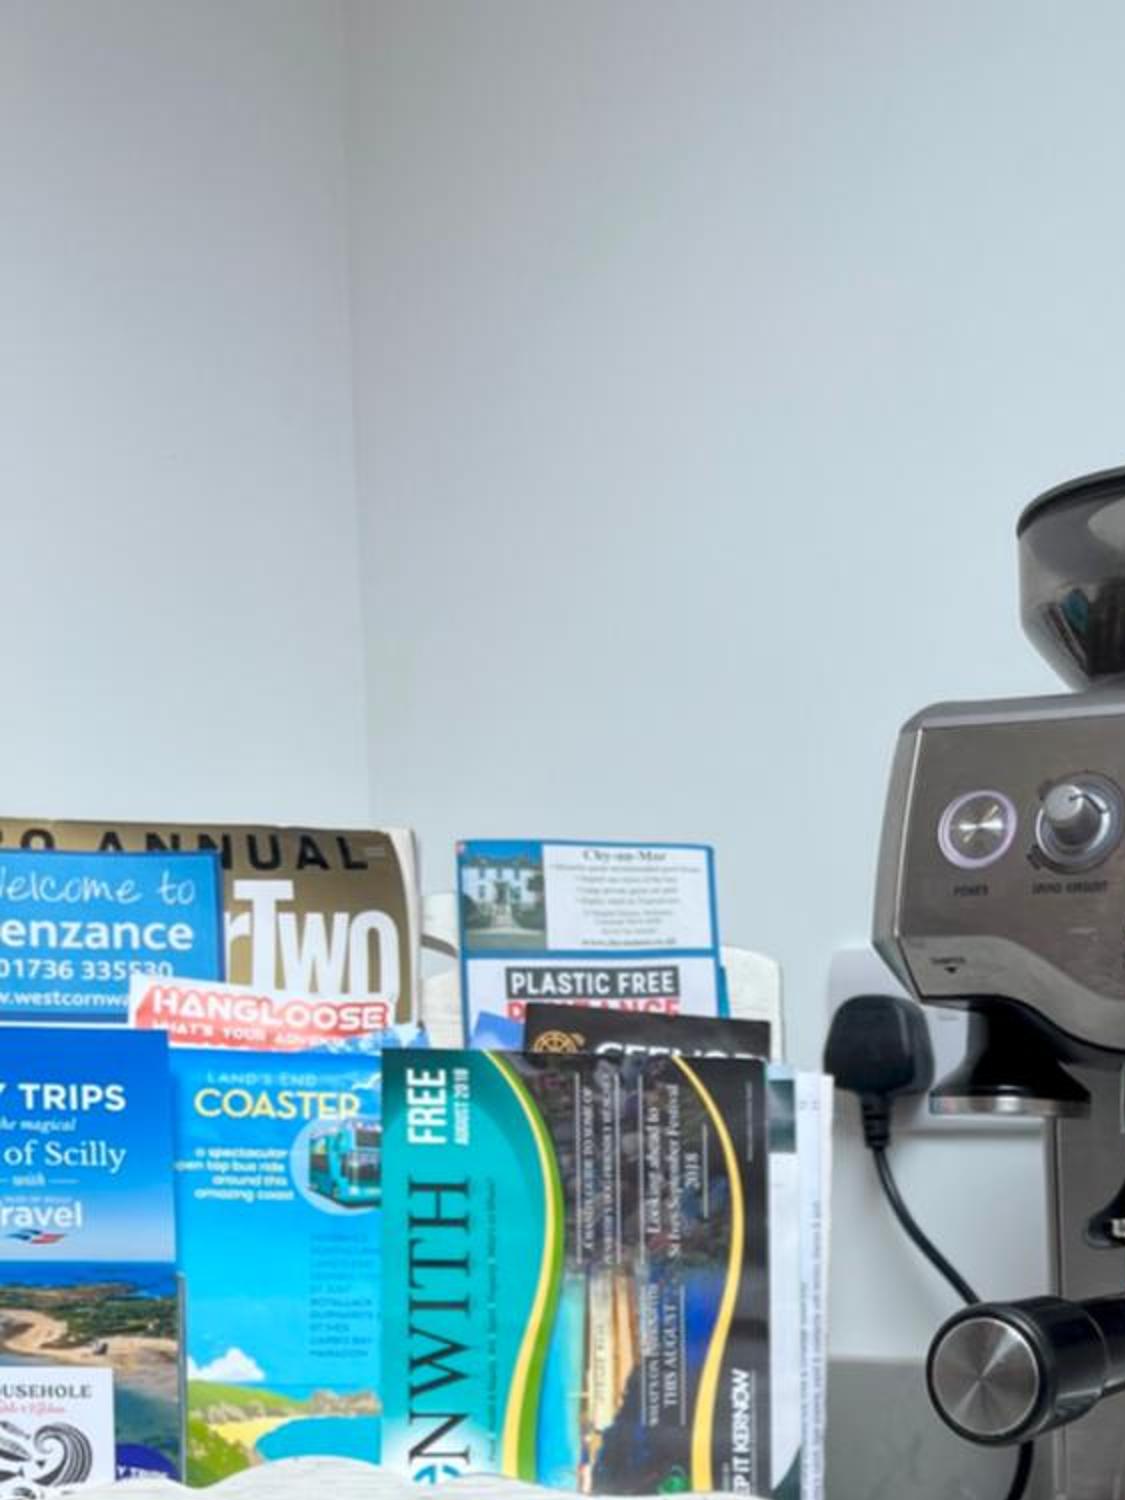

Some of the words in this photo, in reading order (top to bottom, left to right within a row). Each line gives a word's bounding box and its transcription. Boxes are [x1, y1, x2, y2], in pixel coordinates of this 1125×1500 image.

[158, 870, 196, 905] to
[0, 918, 194, 950] enzance
[510, 971, 610, 996] PLASTIC
[618, 970, 675, 993] FREE
[18, 1082, 127, 1112] TRIPS
[194, 1087, 361, 1120] COASTER
[407, 1067, 447, 1145] FREE
[3, 1138, 39, 1167] of
[44, 1138, 127, 1175] Scilly
[0, 1200, 83, 1228] ravel
[645, 1171, 664, 1233] Looking
[407, 1174, 471, 1485] NWITH
[0, 1384, 92, 1399] USEHOLE
[731, 1368, 751, 1453] KERNOW
